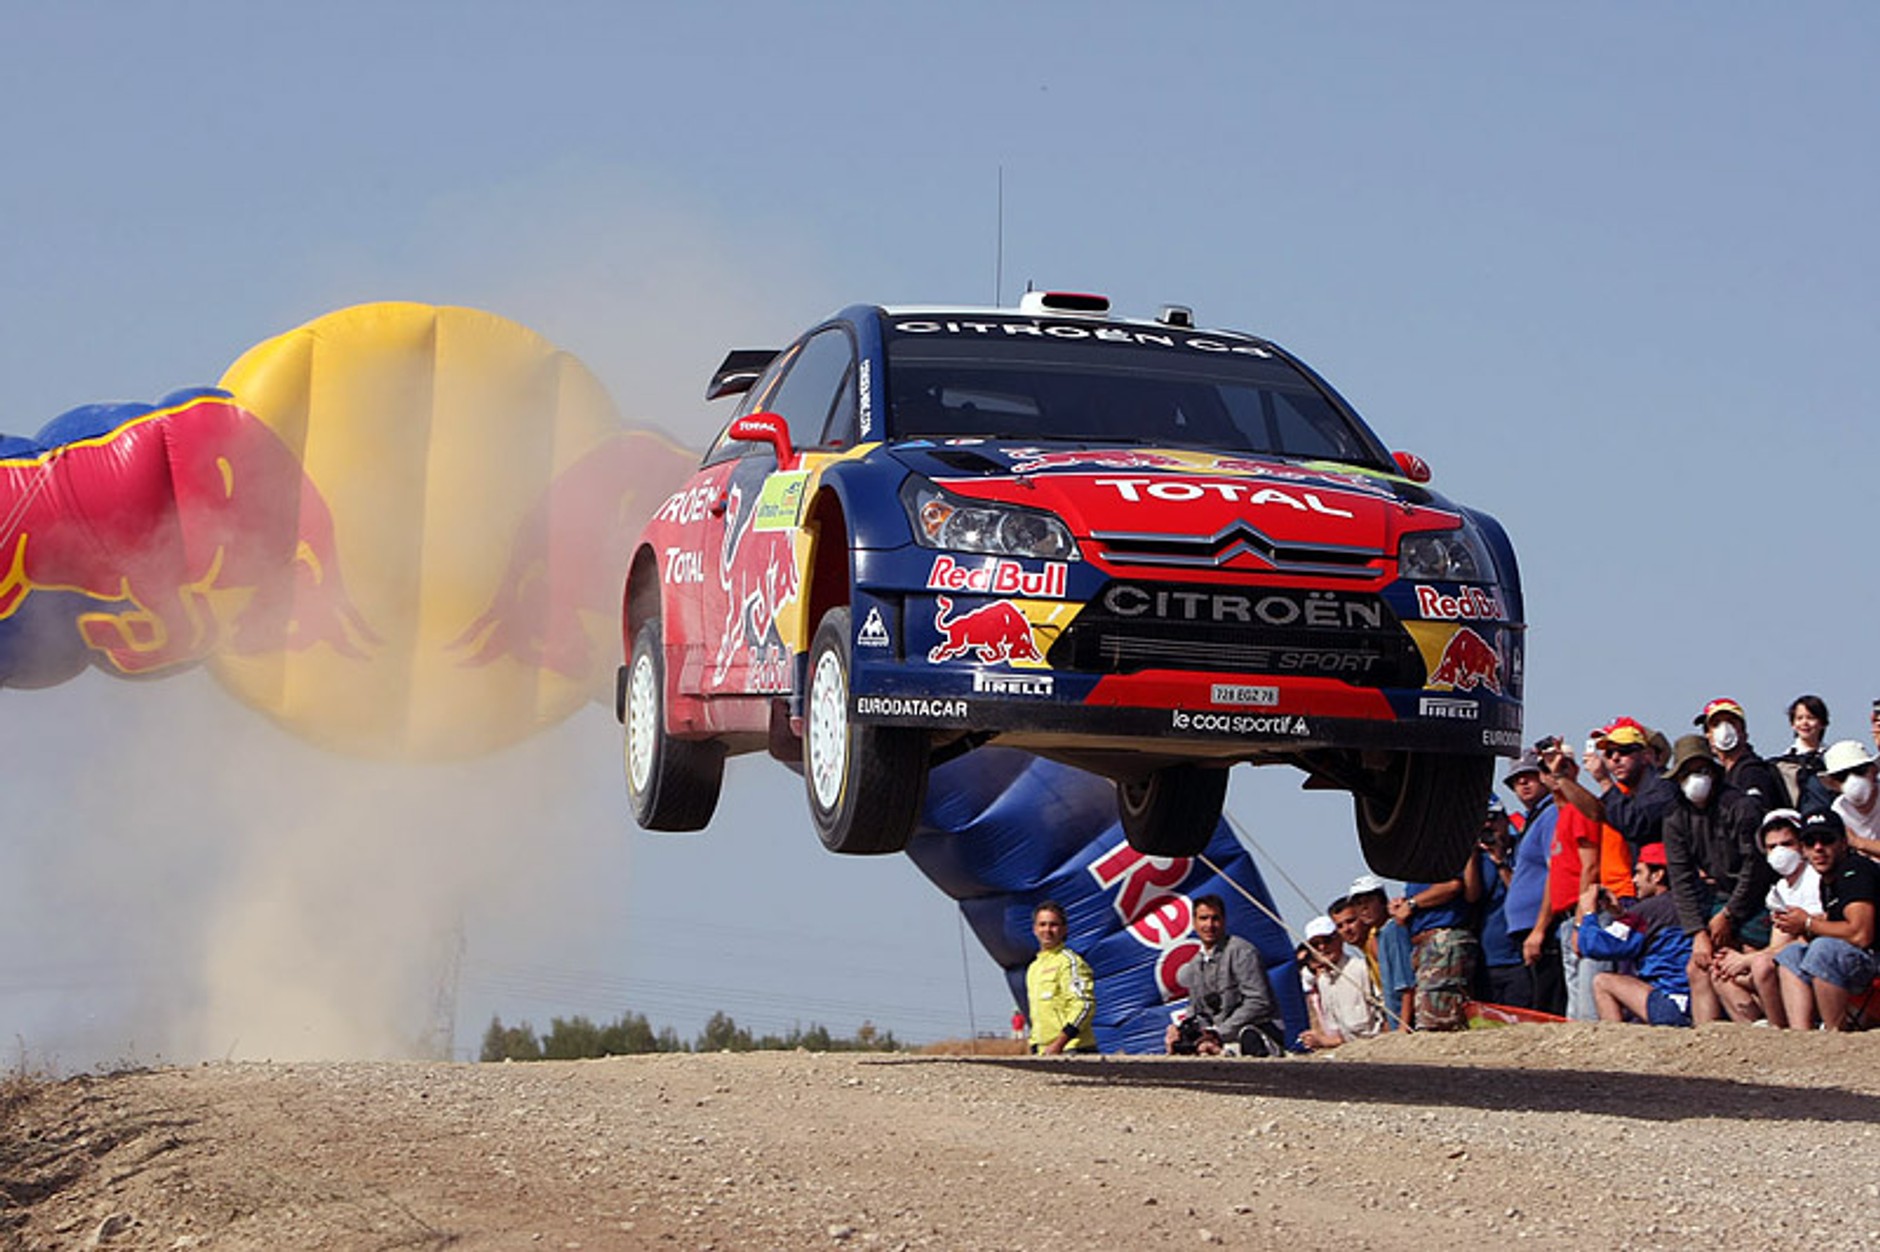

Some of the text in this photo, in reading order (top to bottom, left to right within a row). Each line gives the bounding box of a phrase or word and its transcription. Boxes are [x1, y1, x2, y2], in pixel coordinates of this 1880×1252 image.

[894, 320, 1273, 359] CITROËN C4
[739, 421, 779, 433] TOTAL
[1095, 478, 1354, 518] TOTAL
[665, 547, 705, 583] TOTAL
[926, 554, 1069, 599] Red Bull
[1104, 585, 1381, 629] CITROËN
[1415, 584, 1471, 619] Red
[1278, 653, 1381, 672] SPORT
[973, 670, 1055, 696] PIRELLI
[857, 698, 968, 718] EURODATACAR
[1172, 709, 1292, 735] le coq sportif
[1419, 697, 1480, 720] PIRELLI
